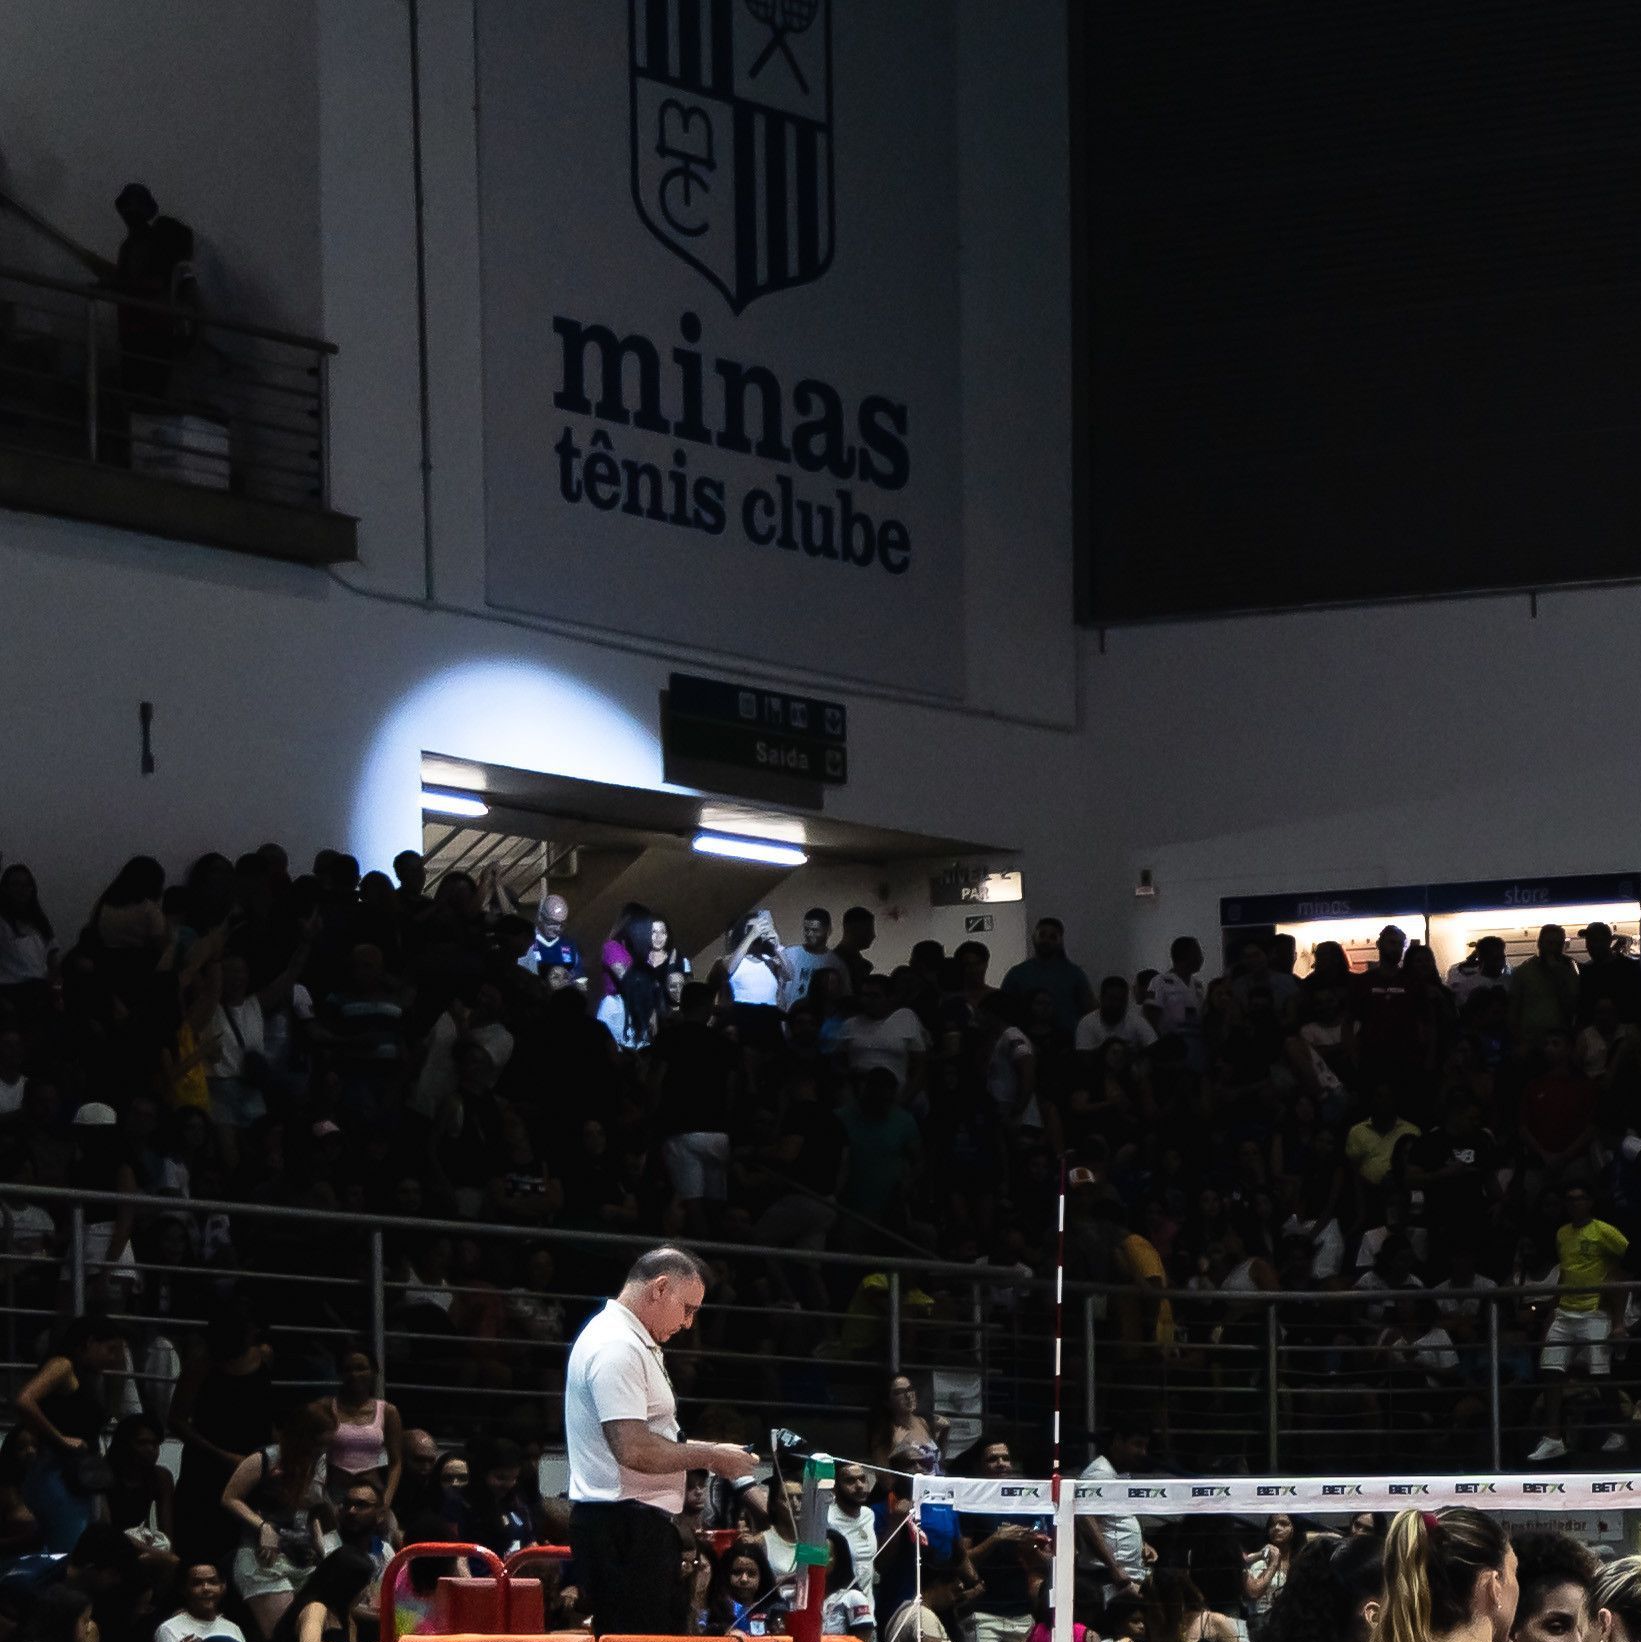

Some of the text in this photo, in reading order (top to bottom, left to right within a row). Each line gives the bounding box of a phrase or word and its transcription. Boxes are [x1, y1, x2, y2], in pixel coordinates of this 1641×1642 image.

[552, 312, 910, 491] minas
[554, 426, 912, 575] tênis clube
[1503, 884, 1550, 905] store
[1073, 1486, 1103, 1499] ET7K
[1127, 1487, 1167, 1499] BET7K
[1256, 1485, 1297, 1497] BET7K
[1388, 1484, 1430, 1496] BET7K
[1522, 1482, 1566, 1494] BET7K
